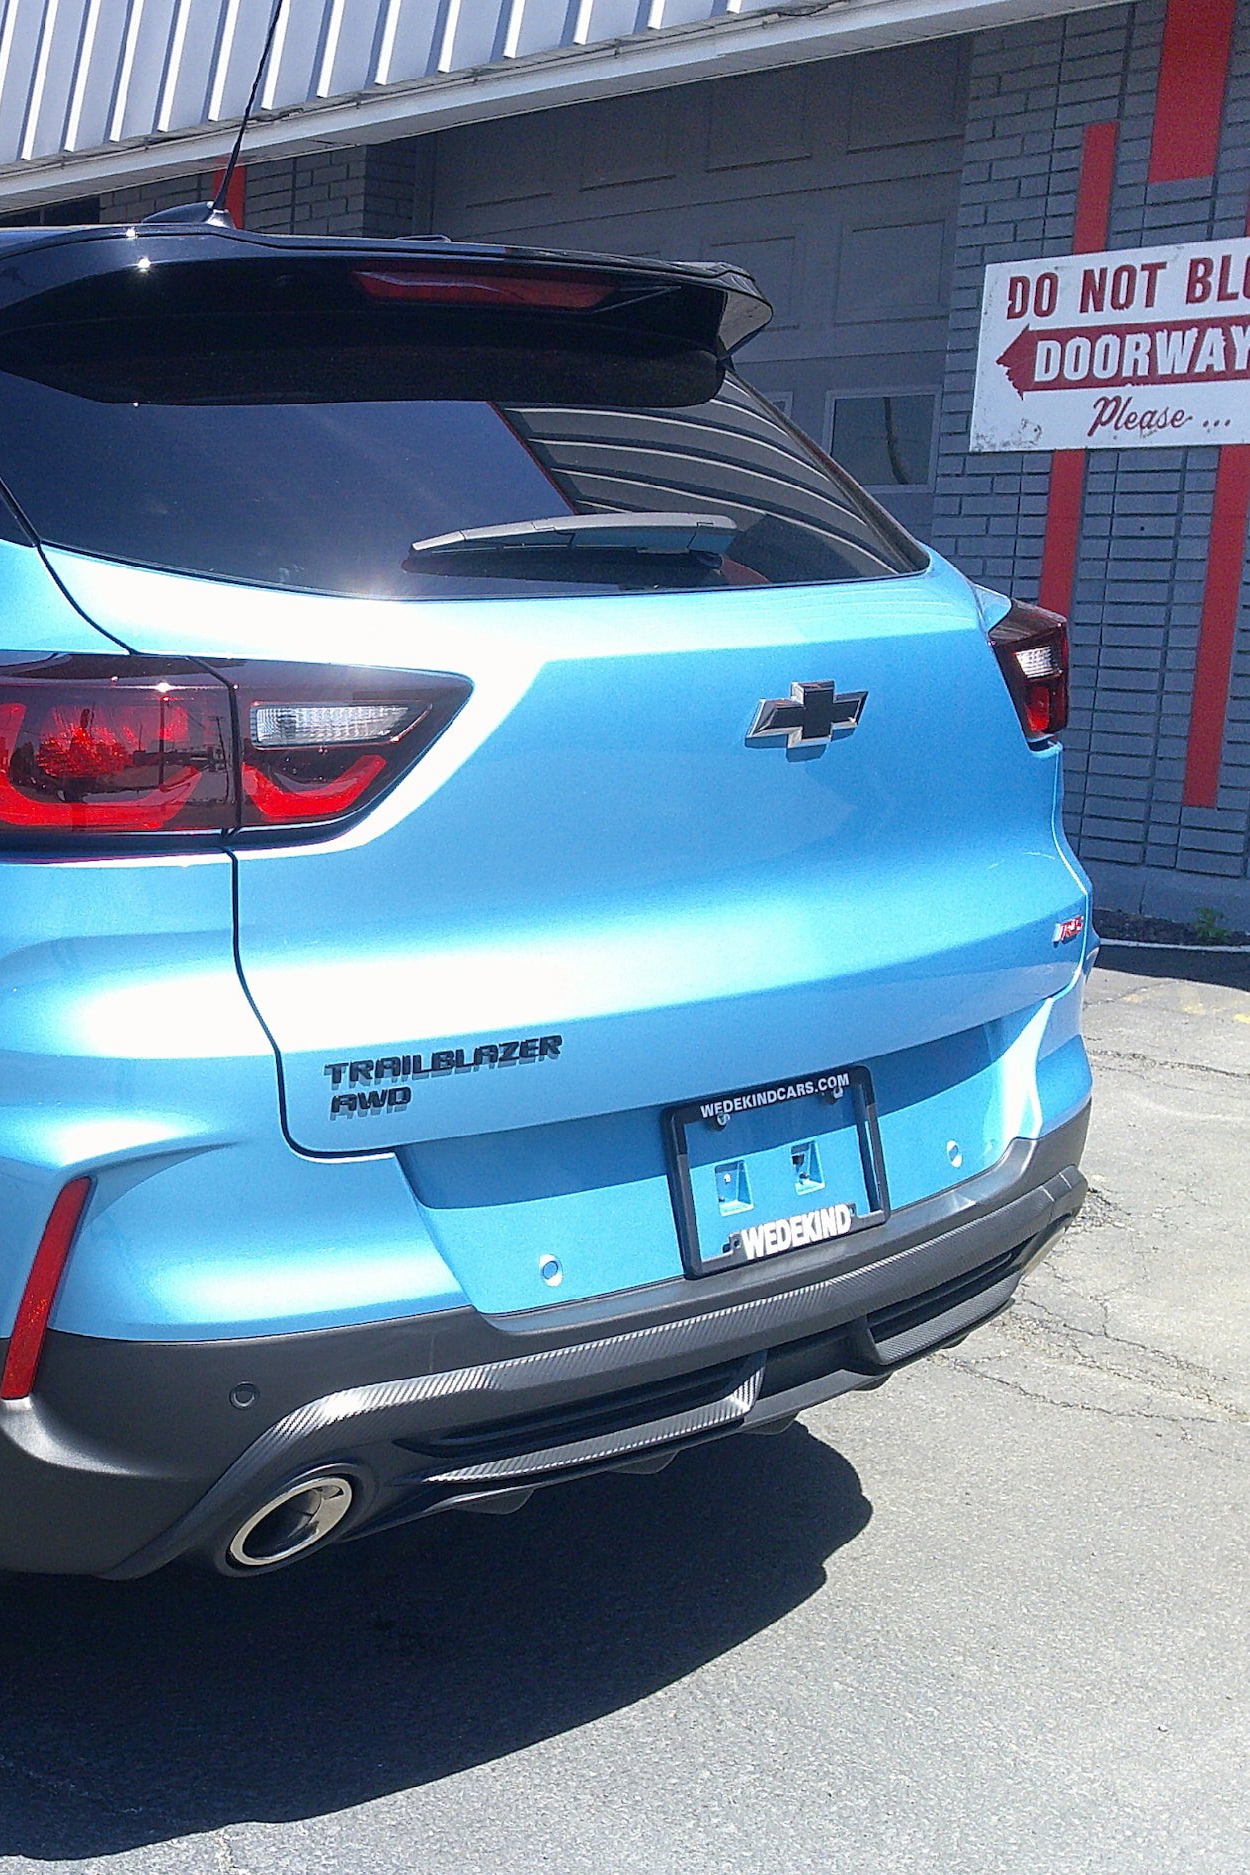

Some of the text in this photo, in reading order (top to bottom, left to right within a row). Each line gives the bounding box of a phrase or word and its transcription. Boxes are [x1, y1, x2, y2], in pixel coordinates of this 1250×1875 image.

[1006, 272, 1059, 320] DO
[1079, 261, 1167, 314] NOT
[324, 1034, 562, 1085] TRAILBLAZER
[330, 1086, 411, 1114] AWD
[700, 1073, 850, 1119] WEDEKINDCARS.COM
[741, 1203, 851, 1260] WEDEKIND
